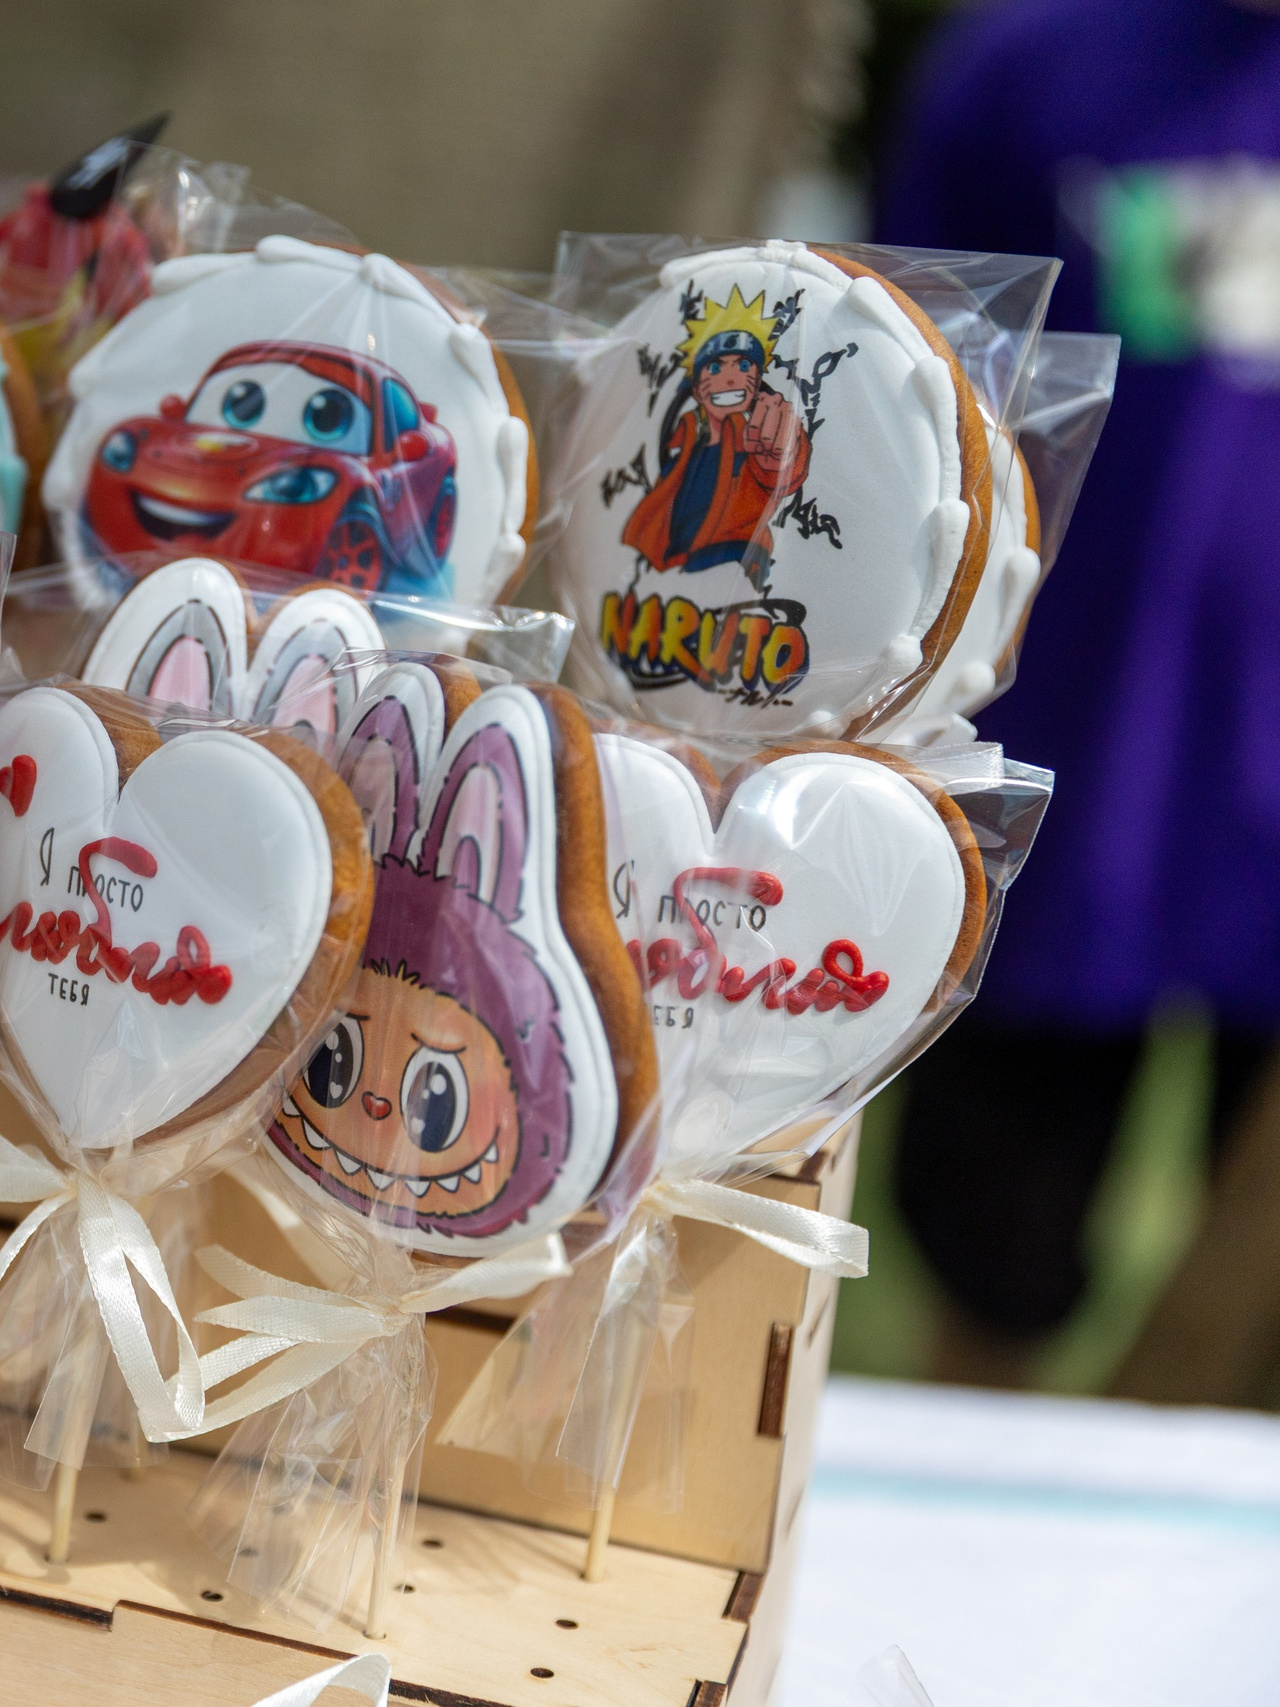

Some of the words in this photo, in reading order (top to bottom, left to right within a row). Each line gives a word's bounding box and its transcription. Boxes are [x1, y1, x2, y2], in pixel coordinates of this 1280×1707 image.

[600, 590, 810, 693] NARUTO
[39, 827, 55, 887] Я
[67, 865, 144, 913] ПОСТО
[613, 859, 635, 919] Я
[625, 866, 890, 1016] юблю
[48, 972, 90, 1006] ТЕБЯ
[652, 1004, 695, 1029] ЕБЯ
